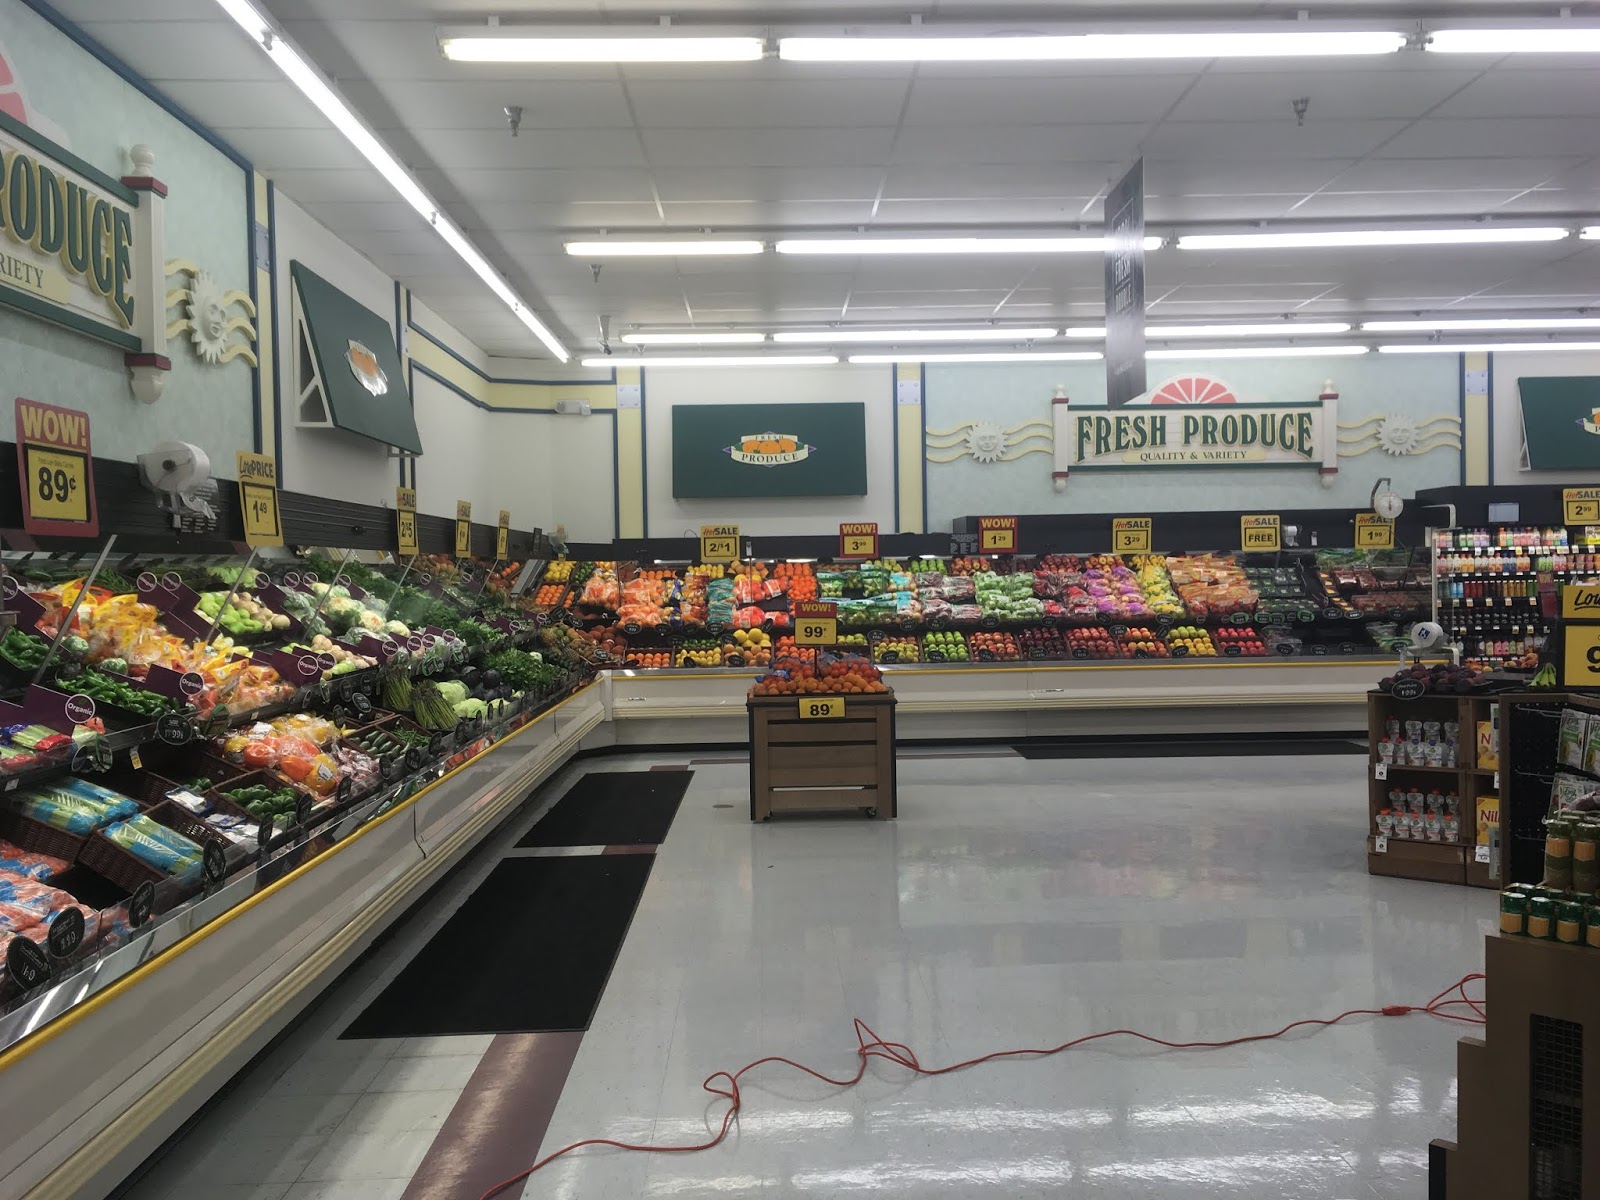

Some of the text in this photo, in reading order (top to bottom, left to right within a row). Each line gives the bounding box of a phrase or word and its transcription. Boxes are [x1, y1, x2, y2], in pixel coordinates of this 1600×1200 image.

[0, 150, 135, 328] ODUCE
[20, 404, 87, 447] WOW!
[1076, 412, 1313, 463] FRESH PRODUCE
[741, 452, 799, 463] PRODUCE
[1140, 452, 1186, 461] QUALITY
[1202, 450, 1248, 460] VARIETY
[38, 466, 77, 503] 89¢
[981, 518, 1015, 528] WOW!
[842, 524, 876, 534] WOW!
[1248, 533, 1273, 542] FREE
[801, 603, 832, 612] WOW!
[181, 678, 203, 690] Organic
[67, 702, 93, 716] Organic
